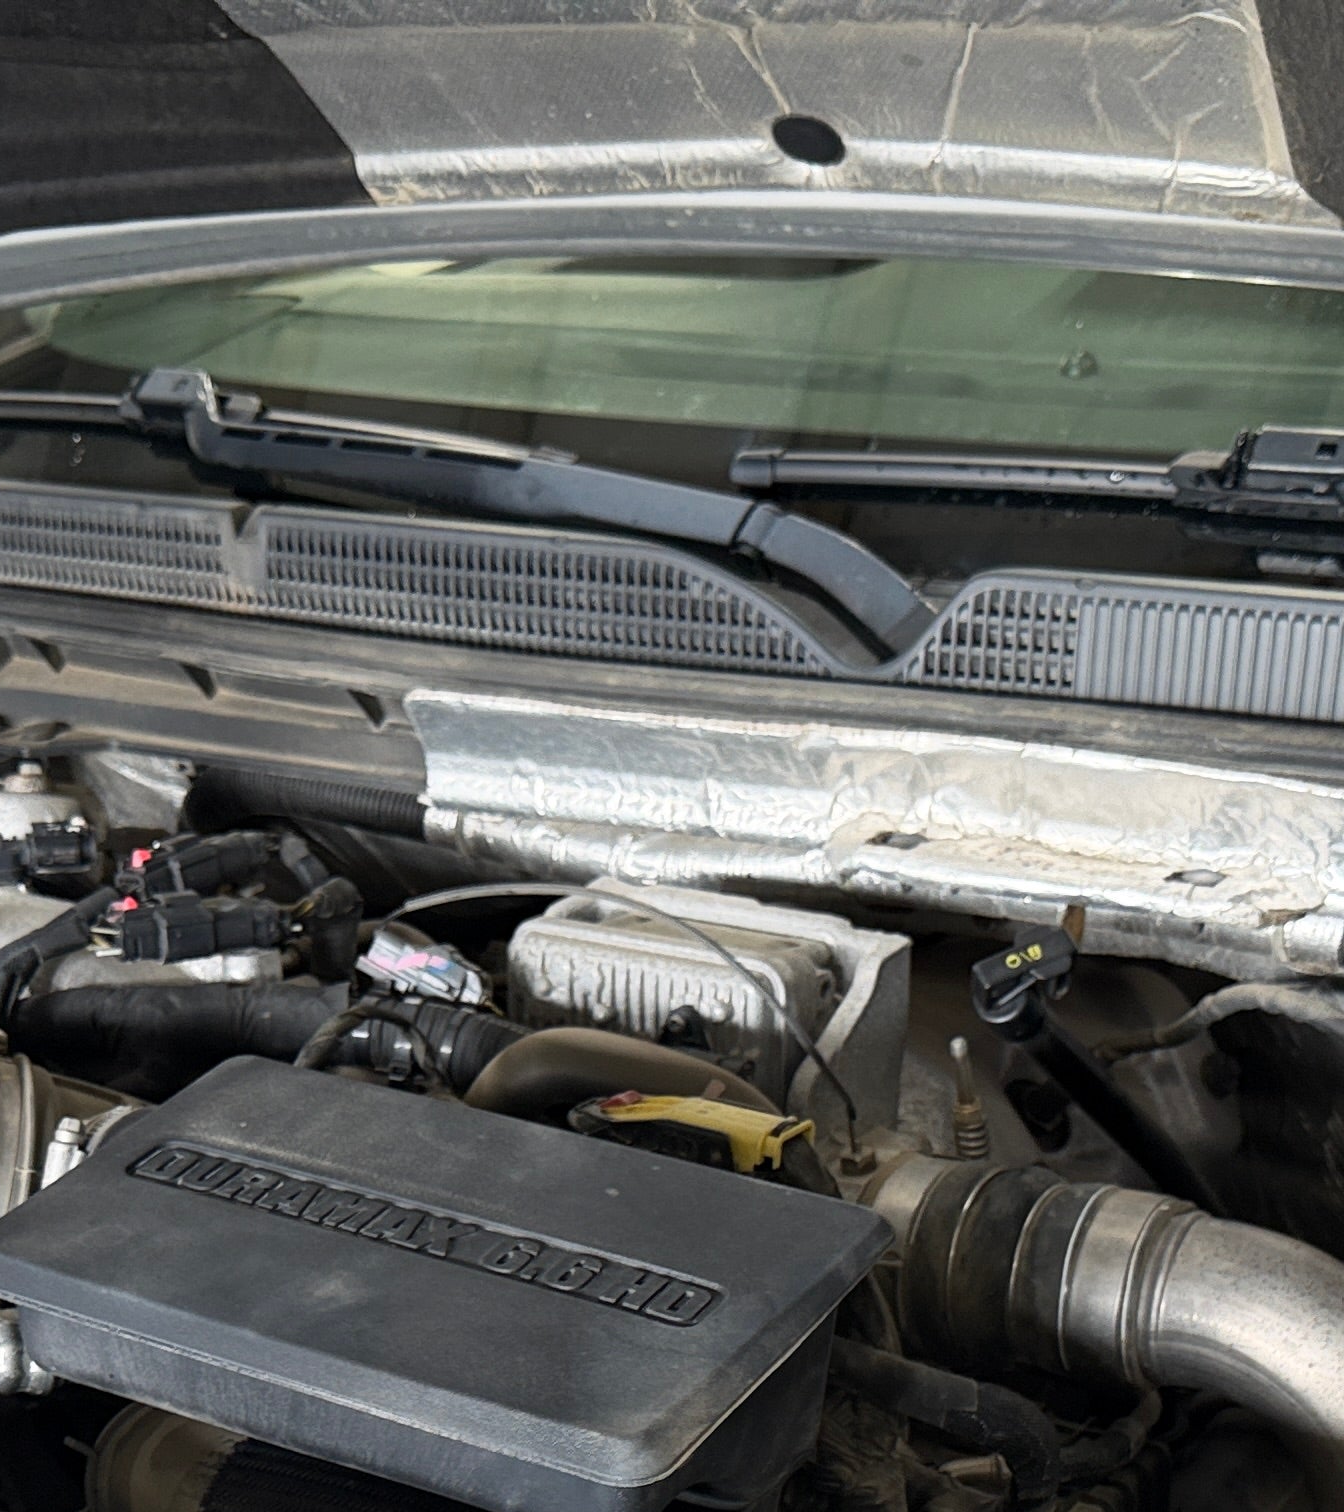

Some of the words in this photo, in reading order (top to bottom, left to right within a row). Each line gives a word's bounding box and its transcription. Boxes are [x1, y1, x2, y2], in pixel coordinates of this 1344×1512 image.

[132, 1146, 479, 1258] DURAMAX
[480, 1237, 602, 1292] 6.6
[598, 1264, 716, 1324] HD
